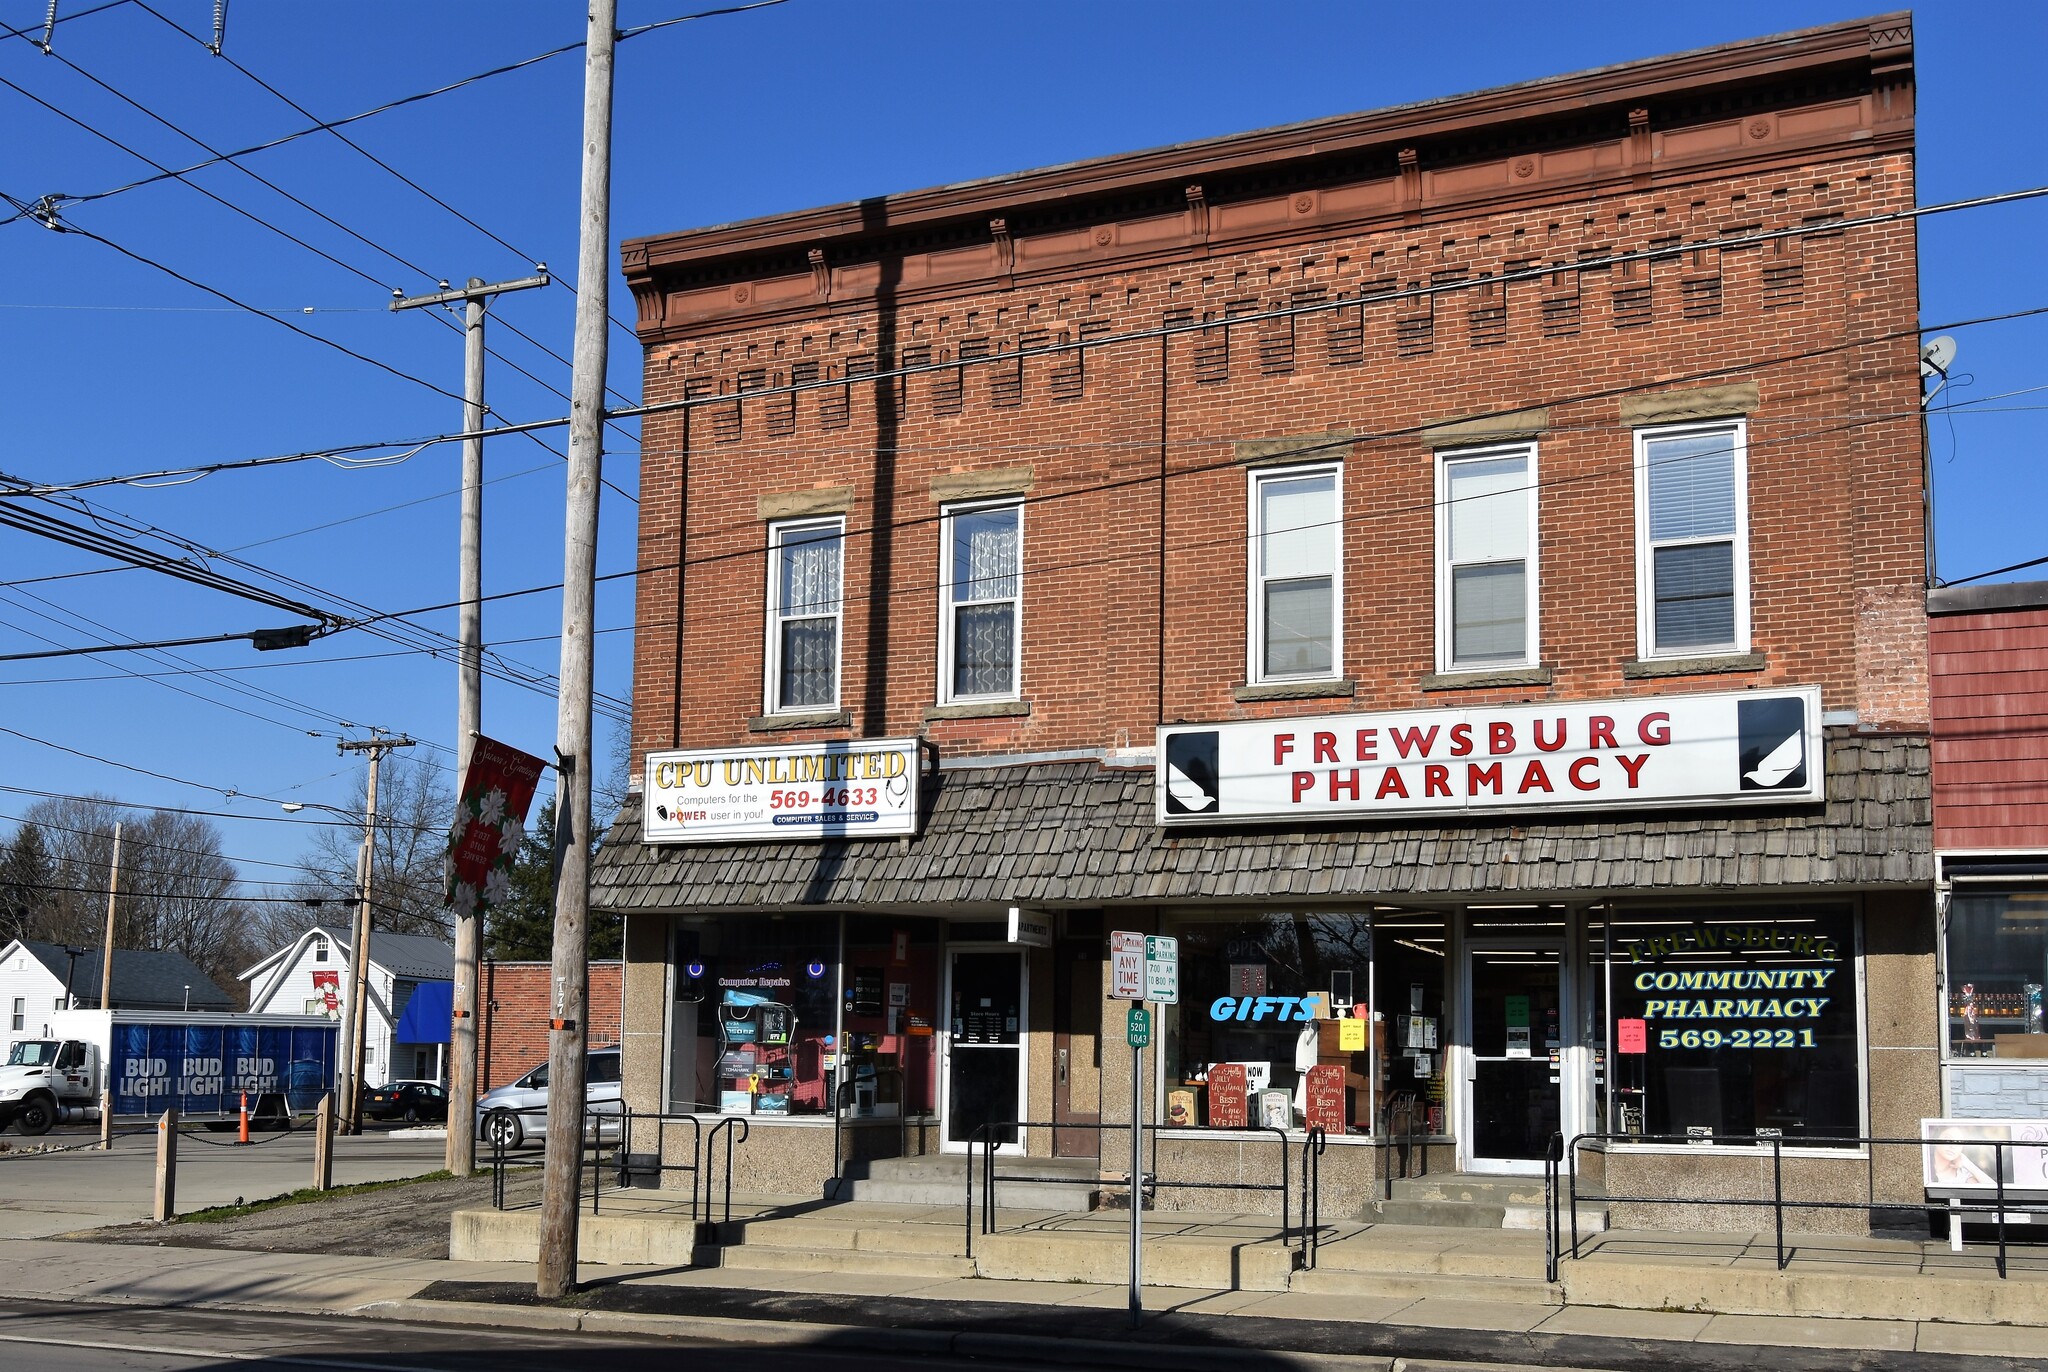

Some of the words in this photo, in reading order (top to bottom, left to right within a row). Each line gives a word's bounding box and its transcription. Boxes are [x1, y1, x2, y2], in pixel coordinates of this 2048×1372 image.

[1273, 711, 1672, 766] FREWSBURG
[656, 759, 714, 789] CPU
[722, 750, 906, 786] UNLIMITED
[1291, 752, 1651, 803] PHARMACY
[677, 795, 726, 806] Computers
[728, 793, 741, 803] for
[743, 793, 758, 803] the
[769, 787, 878, 809] 569-4633
[669, 810, 707, 821] POWER
[710, 812, 730, 820] user
[733, 810, 741, 819] in
[744, 809, 764, 821] you!
[776, 815, 813, 823] COMPUTER
[814, 814, 836, 822] SALES
[846, 813, 875, 821] SERVICE
[1113, 935, 1122, 949] NO
[1122, 938, 1143, 948] PARKING
[1146, 941, 1155, 954] 15
[1625, 926, 1841, 965] FREWSBURG
[1156, 950, 1176, 960] PARKING
[1119, 956, 1138, 969] ANY
[1166, 965, 1173, 973] AM
[718, 977, 757, 987] Computer
[759, 977, 791, 987] Repairs
[1118, 971, 1139, 984] TIME
[1148, 976, 1154, 984] TO
[1634, 968, 1836, 991] COMMUNITY
[1209, 996, 1321, 1022] GIFTS
[1642, 996, 1831, 1019] PHARMACY
[1134, 1011, 1143, 1021] 62
[1130, 1022, 1146, 1032] 5201
[1658, 1027, 1818, 1049] 569-2221
[125, 1058, 167, 1077] BUD
[183, 1058, 223, 1076] BUD
[236, 1057, 275, 1076] BUD
[1247, 1066, 1263, 1077] NOW
[231, 1075, 279, 1094] LIGHT
[1215, 1075, 1231, 1083] JOLLY
[119, 1076, 171, 1097] LIGHT
[177, 1076, 226, 1096] LIGHT
[1211, 1083, 1244, 1094] Christmas
[1308, 1085, 1342, 1096] Christmas
[1219, 1096, 1238, 1104] BEST
[1316, 1098, 1336, 1107] BEST
[1211, 1104, 1242, 1116] Time
[1308, 1106, 1340, 1118] Time
